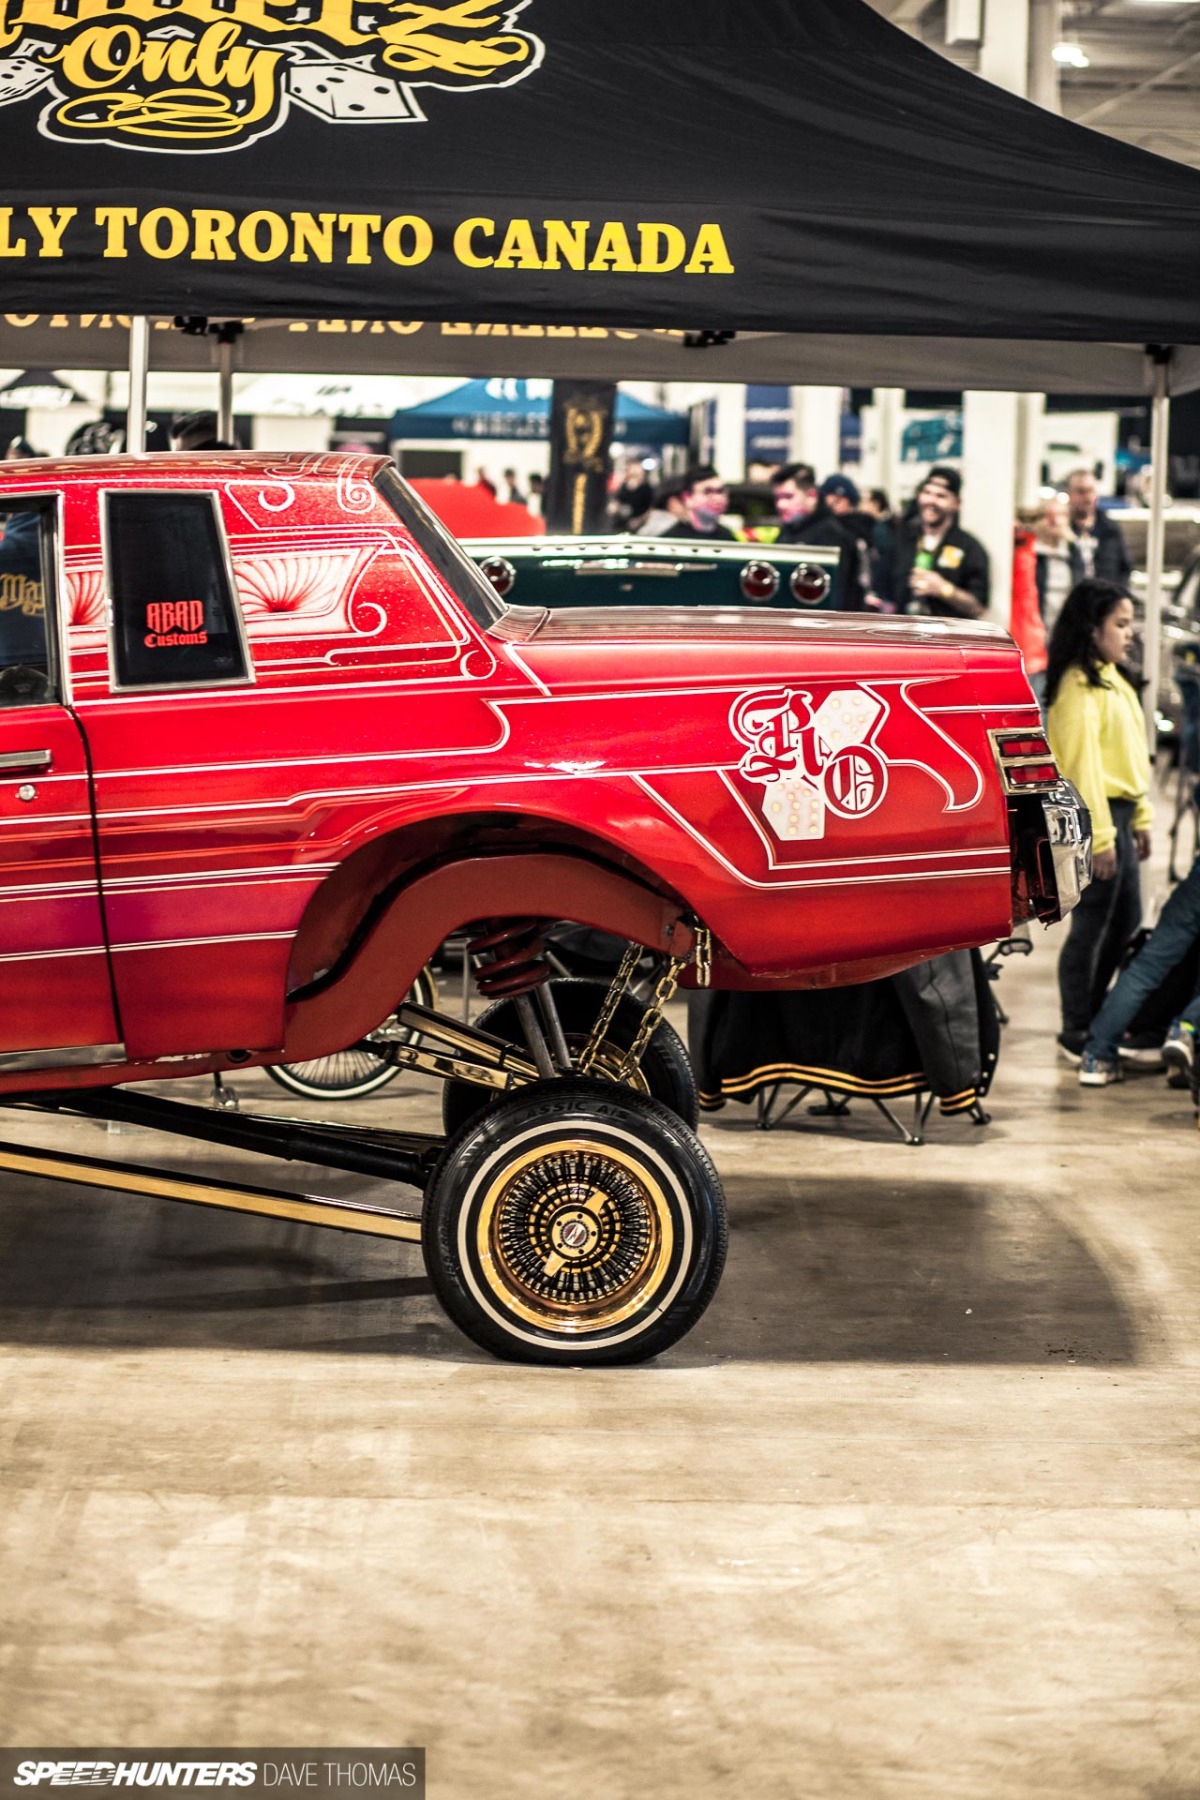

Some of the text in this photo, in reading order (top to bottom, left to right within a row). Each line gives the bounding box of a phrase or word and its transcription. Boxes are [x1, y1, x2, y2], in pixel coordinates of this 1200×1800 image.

[38, 20, 286, 138] Only
[96, 207, 433, 267] TORONTO
[453, 217, 735, 274] CANADA
[144, 630, 208, 648] Customs
[146, 600, 204, 634] ABAD
